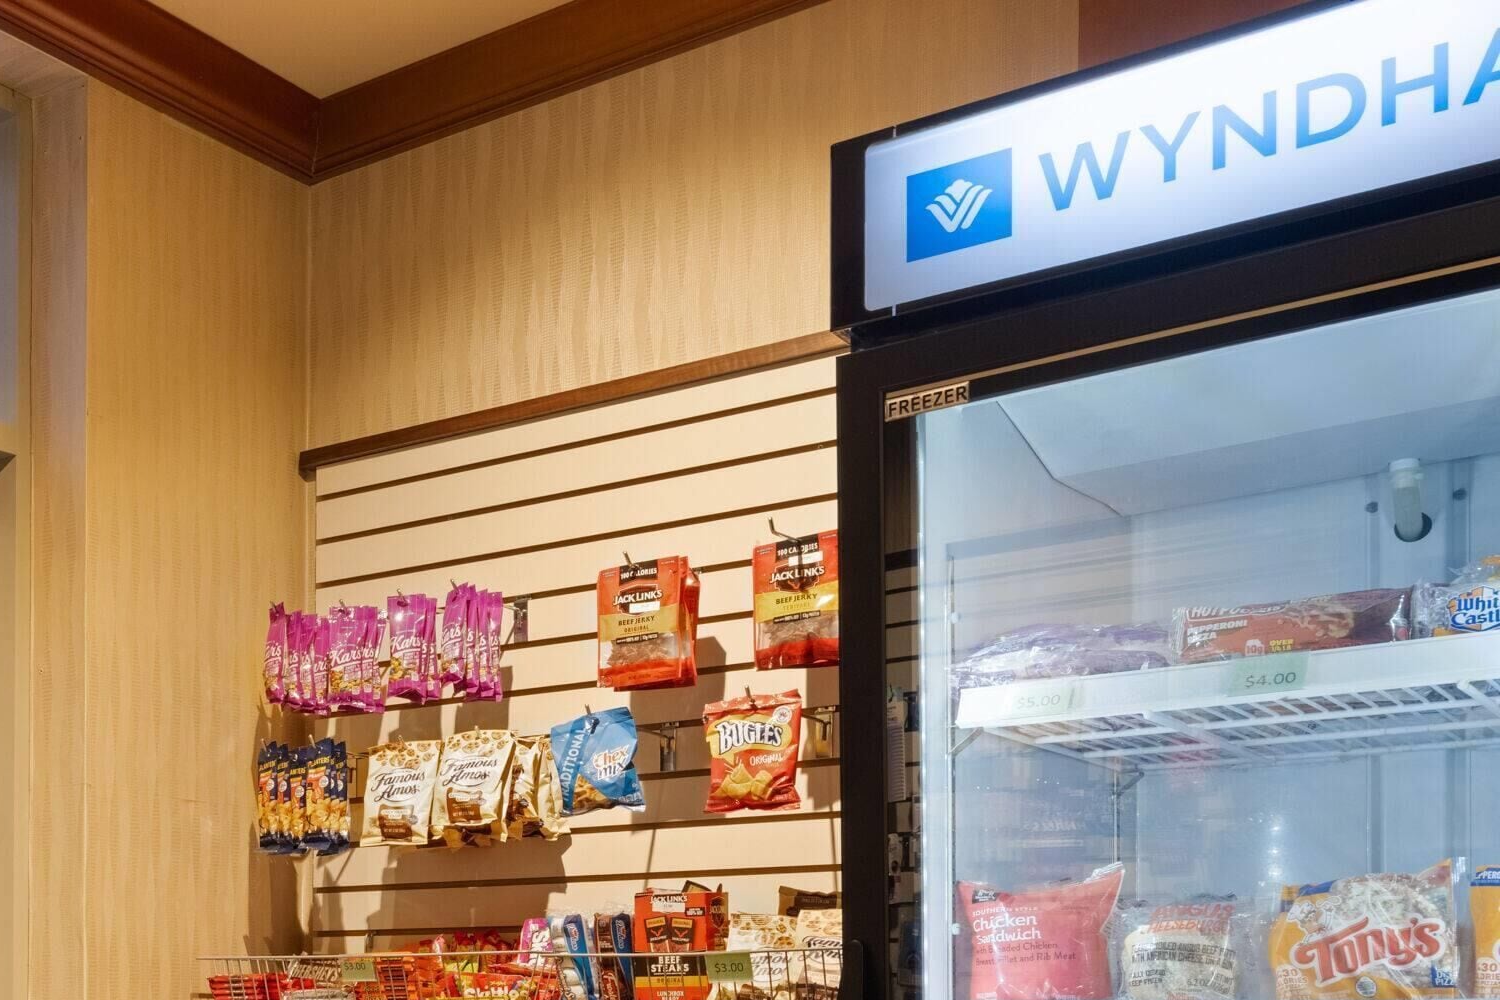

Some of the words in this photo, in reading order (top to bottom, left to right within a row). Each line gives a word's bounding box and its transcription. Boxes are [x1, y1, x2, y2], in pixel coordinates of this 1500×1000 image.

[888, 386, 967, 418] FREEZER
[770, 570, 794, 583] JACK
[613, 594, 636, 606] JACK
[776, 596, 793, 604] BEEF
[794, 594, 817, 602] JERKY
[619, 618, 634, 626] BEEF
[635, 615, 655, 624] JERKY
[1246, 672, 1296, 688] $4.00
[1017, 694, 1061, 709] $5.00
[717, 720, 783, 754] BUGLES
[440, 758, 498, 777] Famous
[750, 754, 784, 766] ORIGINAL
[371, 770, 426, 792] Famous
[442, 770, 491, 787] Amos
[374, 784, 420, 803] Amos
[973, 914, 1038, 933] Chicken
[976, 927, 1043, 945] Sandwich
[1053, 951, 1077, 961] Meat
[1295, 916, 1441, 983] Tony's
[344, 962, 366, 972] $3.00
[658, 955, 681, 964] BEEF
[651, 963, 690, 973] STEAKS
[714, 962, 744, 974] $3.00
